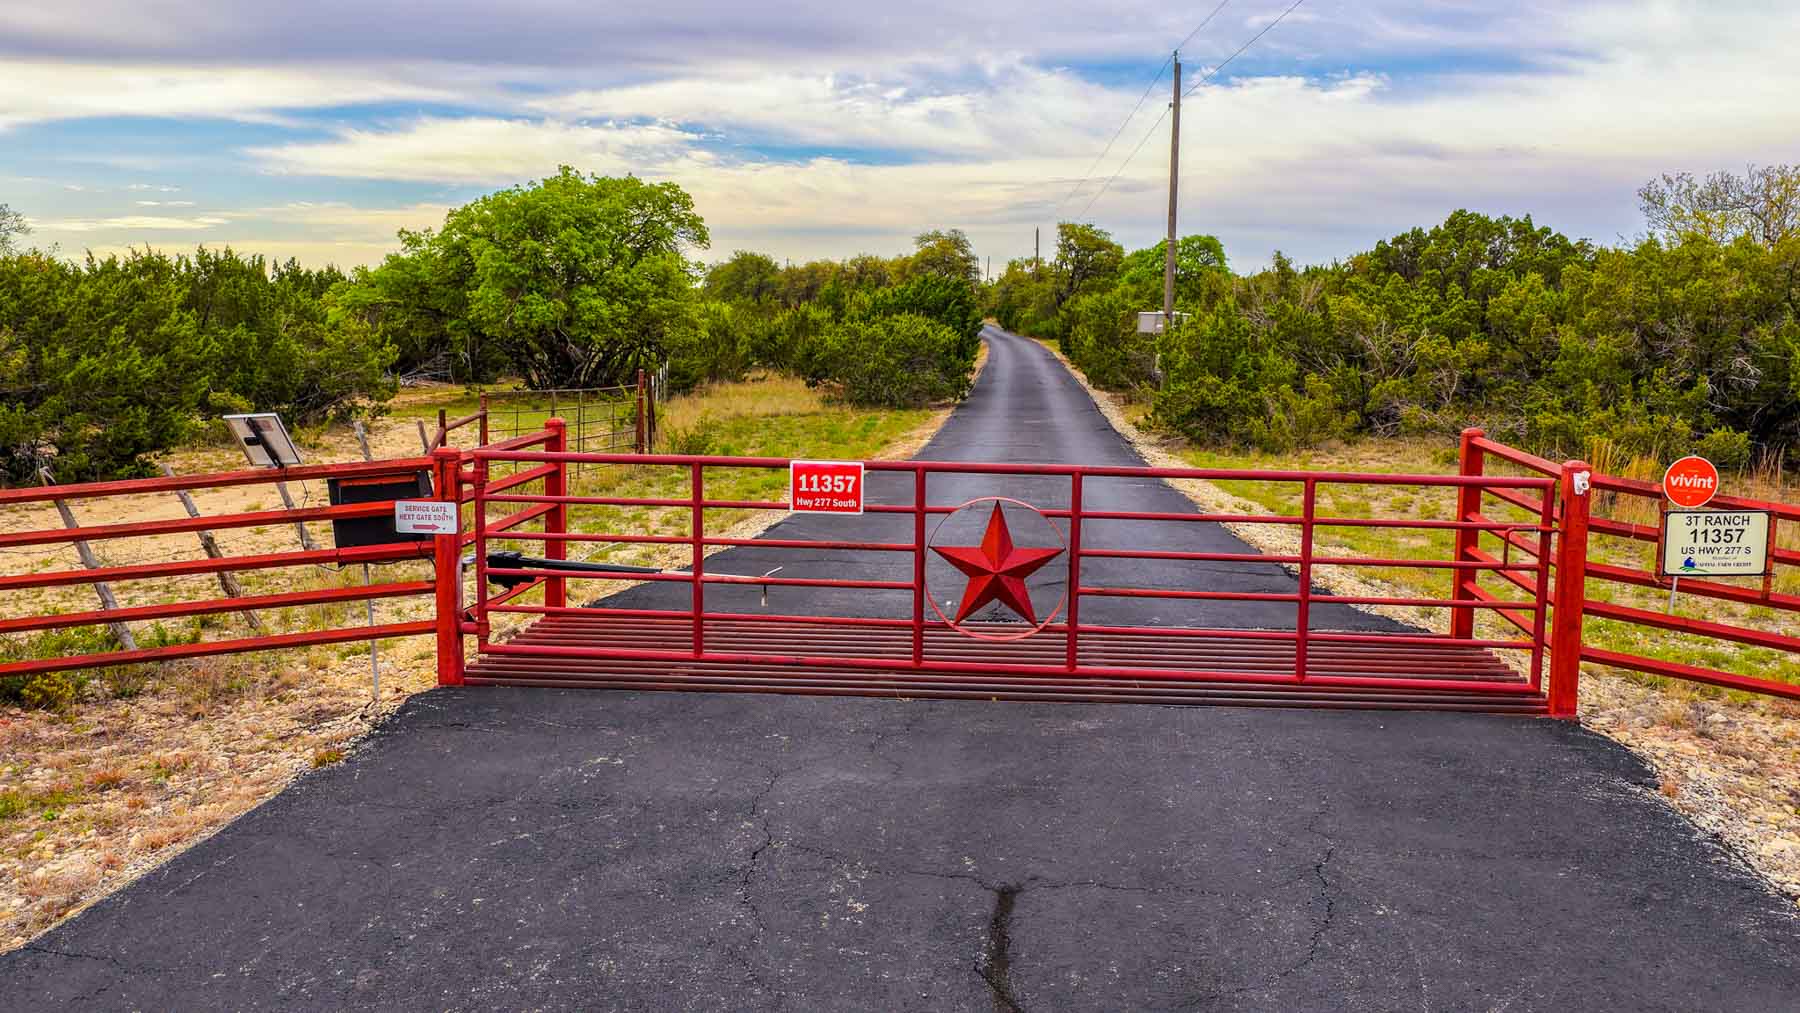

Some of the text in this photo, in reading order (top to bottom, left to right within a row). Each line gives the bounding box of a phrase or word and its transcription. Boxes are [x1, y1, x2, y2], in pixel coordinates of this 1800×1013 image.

[799, 474, 857, 493] 11357
[1670, 473, 1713, 489] vivint
[431, 505, 448, 513] GATE
[797, 497, 857, 508] Hwy 277 South
[1685, 515, 1750, 526] 3T RANCH
[1690, 528, 1745, 544] 11357
